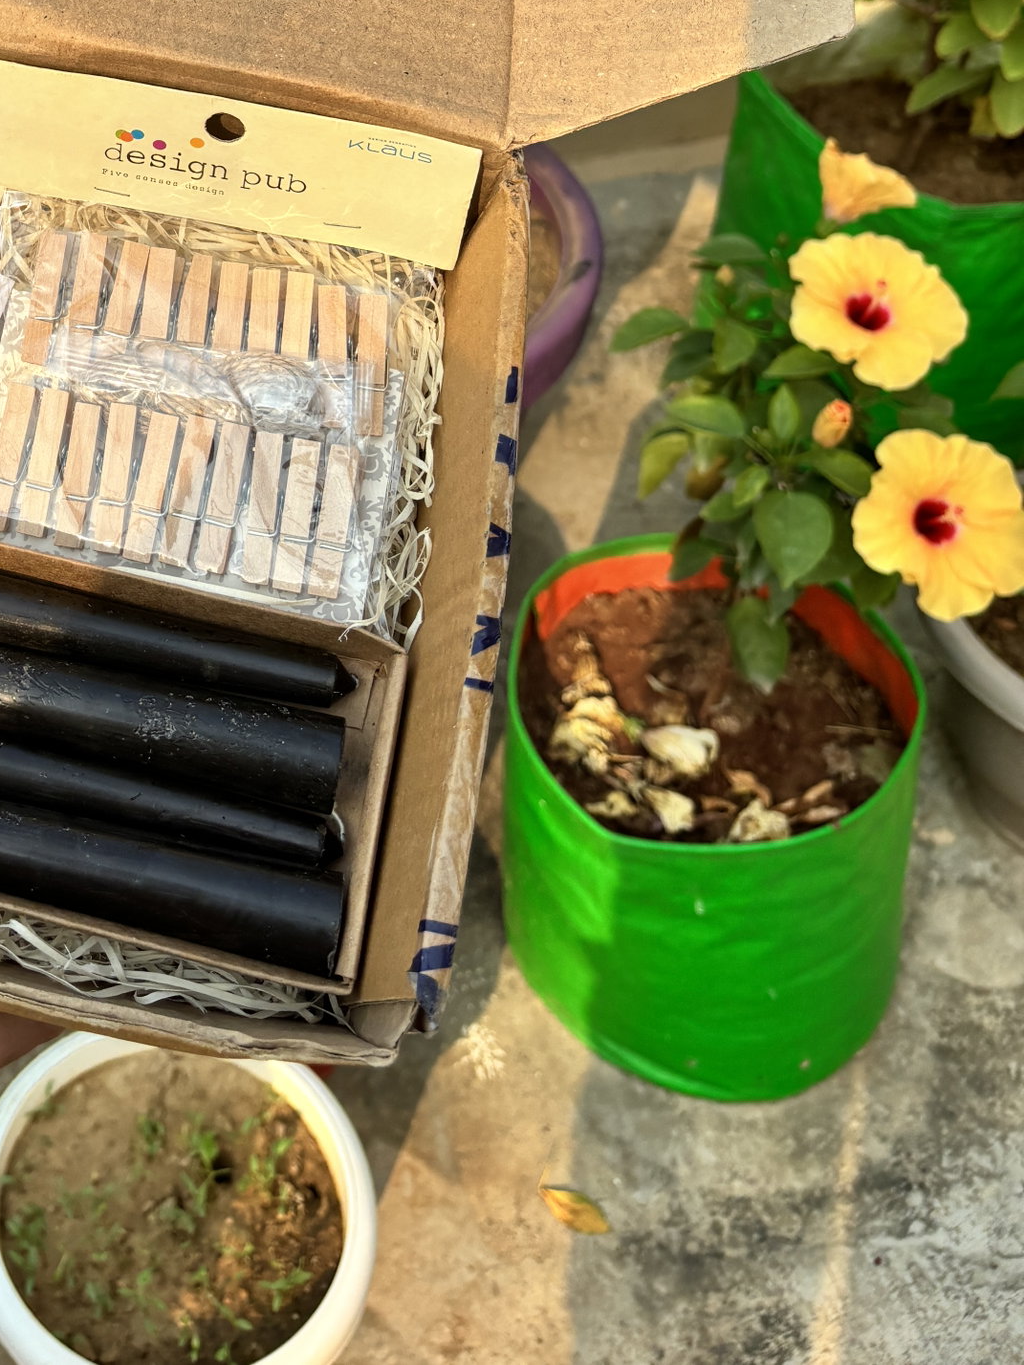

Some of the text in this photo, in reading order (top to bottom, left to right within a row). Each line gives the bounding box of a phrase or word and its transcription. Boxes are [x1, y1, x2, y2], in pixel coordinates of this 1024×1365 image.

[104, 142, 307, 194] design pub
[184, 182, 225, 196] design
